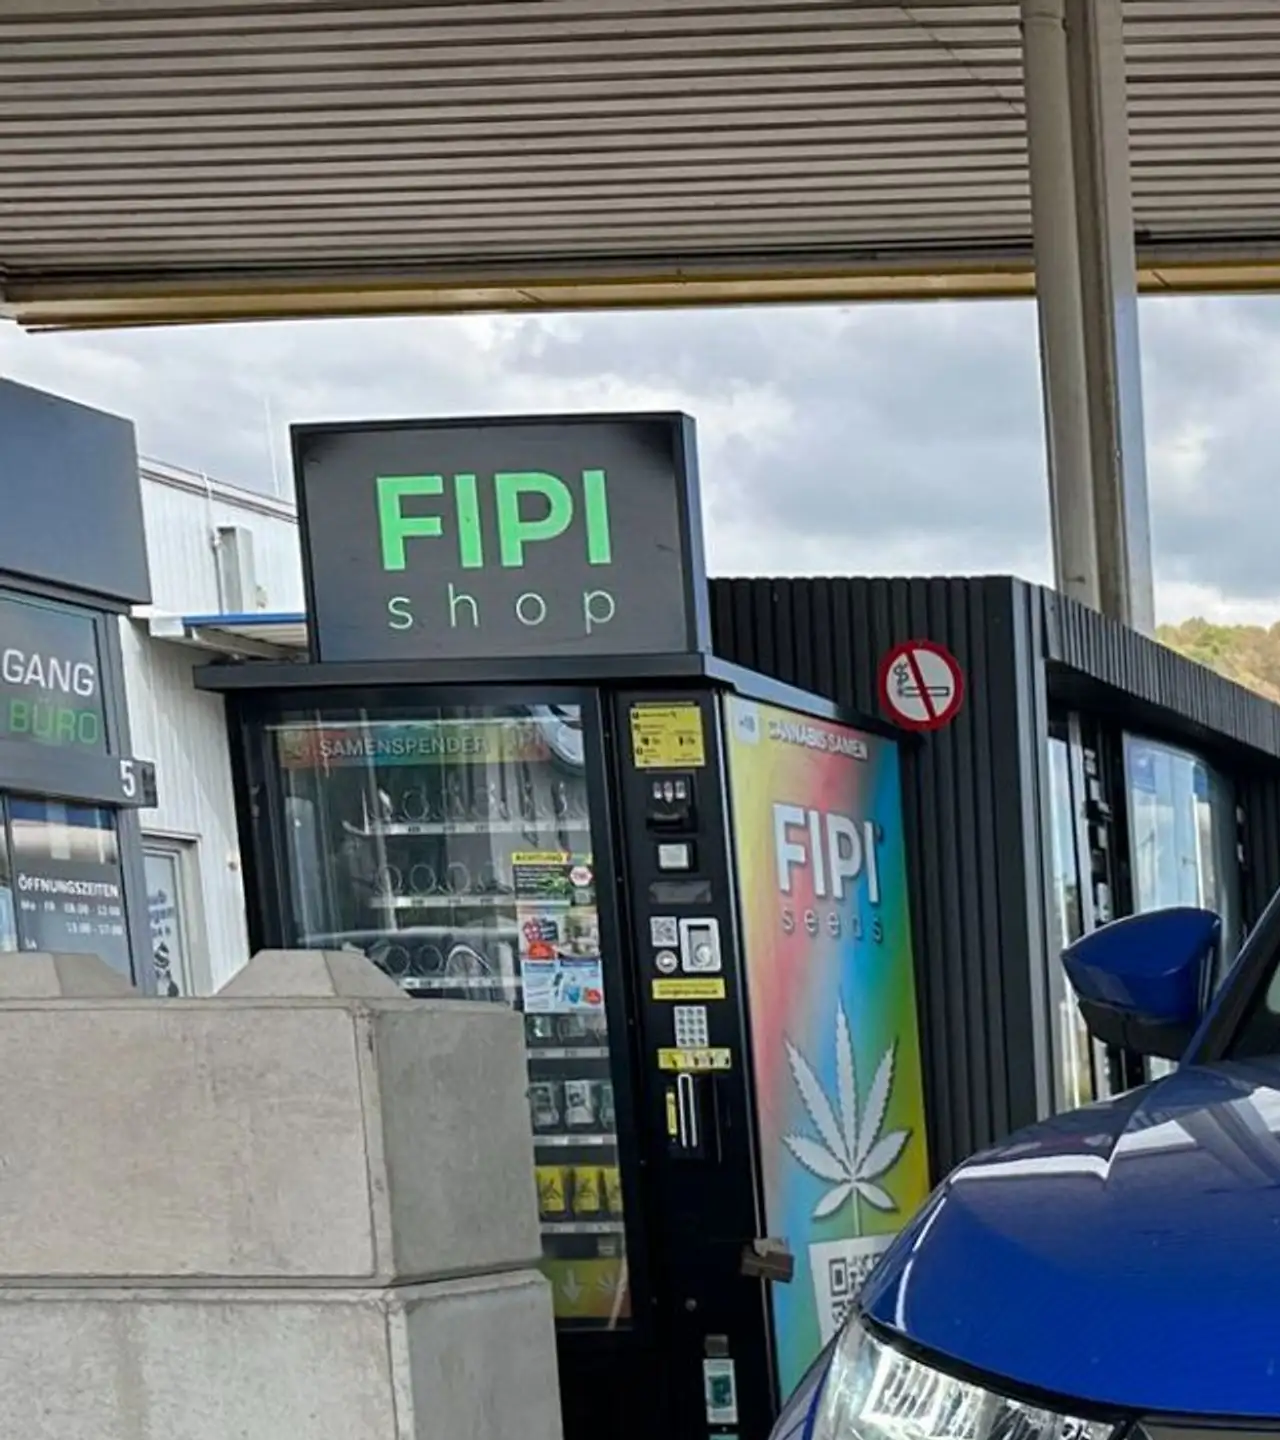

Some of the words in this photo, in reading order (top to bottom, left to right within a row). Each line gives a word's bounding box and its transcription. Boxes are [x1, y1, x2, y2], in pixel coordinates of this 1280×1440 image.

[375, 469, 613, 571] FIPI
[387, 582, 616, 634] shop
[2, 648, 95, 697] GANG
[9, 696, 99, 746] BÜRO
[119, 759, 136, 798] 5
[771, 803, 880, 904] FIPI
